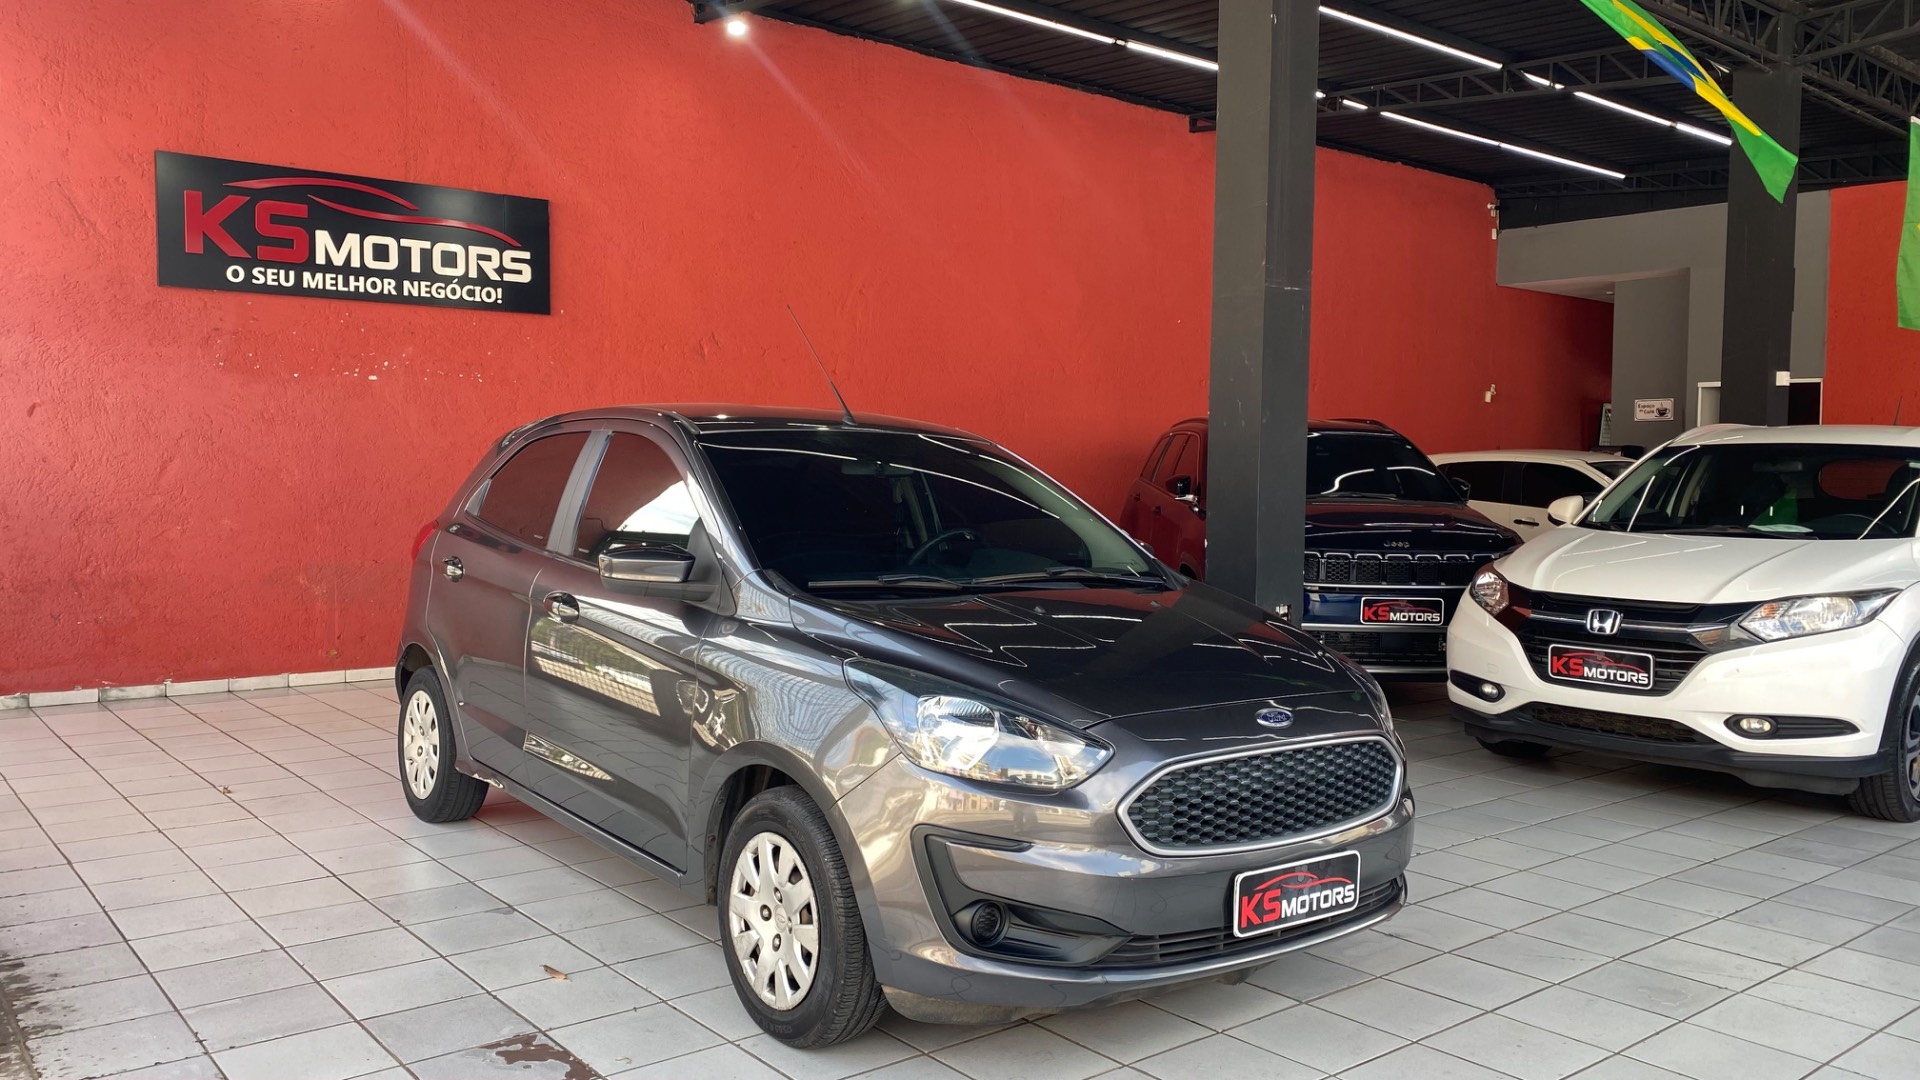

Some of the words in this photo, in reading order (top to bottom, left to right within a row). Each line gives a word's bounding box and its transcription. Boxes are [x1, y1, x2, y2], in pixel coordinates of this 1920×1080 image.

[314, 229, 533, 284] MOTORS
[226, 265, 245, 283] O
[251, 266, 296, 288] SEU
[302, 271, 398, 296] MELHOR
[402, 278, 503, 304] NEGÓCIO!
[1364, 606, 1391, 622] KS
[1389, 611, 1441, 623] MOTORS
[1552, 655, 1584, 676] KS
[1583, 666, 1649, 685] MOTORS
[1241, 889, 1282, 929] KS
[1280, 884, 1356, 919] MOTORS
